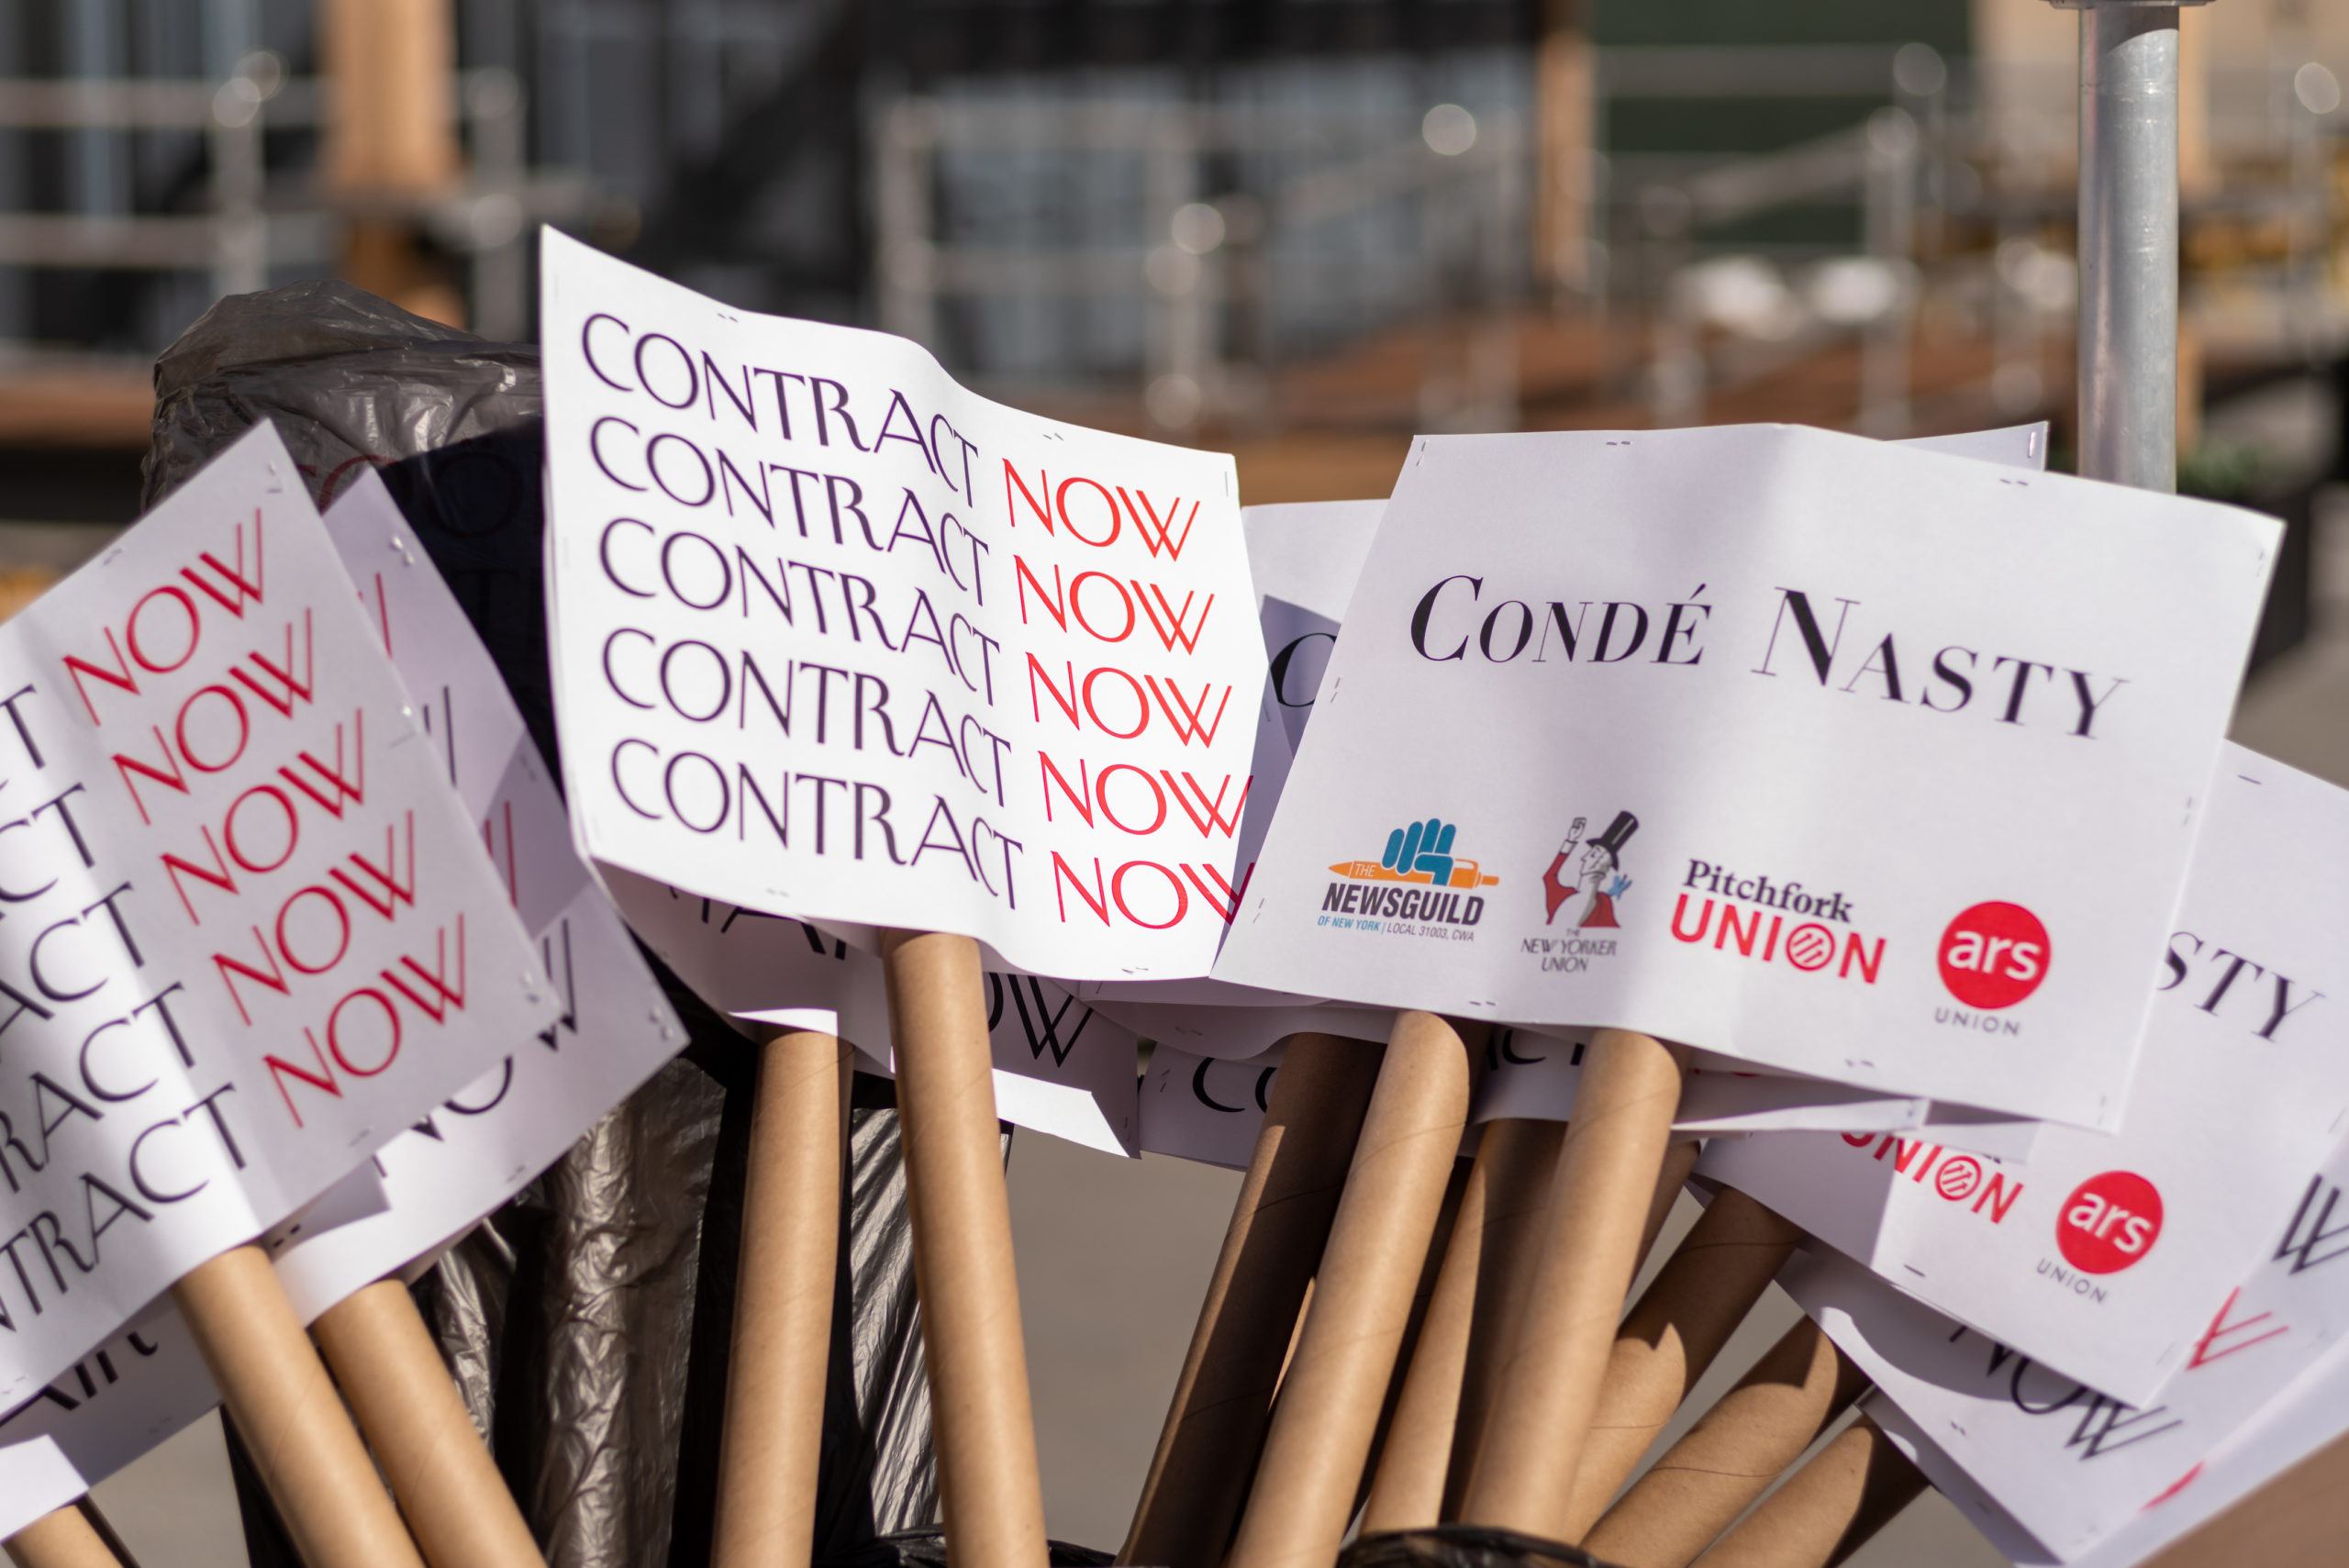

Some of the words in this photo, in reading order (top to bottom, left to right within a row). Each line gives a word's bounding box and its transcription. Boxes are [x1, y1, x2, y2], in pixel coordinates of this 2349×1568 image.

[582, 313, 978, 507] CONTRACT
[1001, 457, 1200, 562] NOW
[590, 417, 989, 606] CONTRACT
[1013, 554, 1215, 655] NOW
[62, 507, 264, 727] NOW
[599, 517, 1000, 706] CONTRACT
[1025, 651, 1232, 748] NOW
[1410, 575, 1712, 665] CONDÉ
[1751, 586, 2130, 739] NASTY
[111, 606, 314, 826] NOW
[603, 628, 1011, 807] CONTRACT
[1038, 751, 1253, 839] NOW
[160, 707, 364, 926] NOW
[611, 738, 1023, 910] CONTRACT
[1354, 863, 1375, 877] THE
[211, 809, 415, 1027] NOW
[1318, 916, 1330, 926] OF
[1332, 917, 1353, 929] NEW
[1355, 920, 1381, 931] YORK
[1386, 923, 1417, 936] LOCAL
[1452, 929, 1475, 941] CWA
[1321, 883, 1485, 926] NEWSGUILD
[1520, 938, 1560, 954] NEW
[1561, 939, 1618, 956] YORKER
[1670, 893, 1887, 984] UNION
[1683, 859, 1854, 923] Pitchfork
[1542, 956, 1589, 973] UNION
[1947, 930, 2042, 981] ars
[2156, 931, 2327, 1043] STY
[262, 912, 465, 1129] NOW
[1934, 1007, 2022, 1037] UNION
[2067, 1192, 2152, 1254] ars
[2036, 1258, 2109, 1303] UNION
